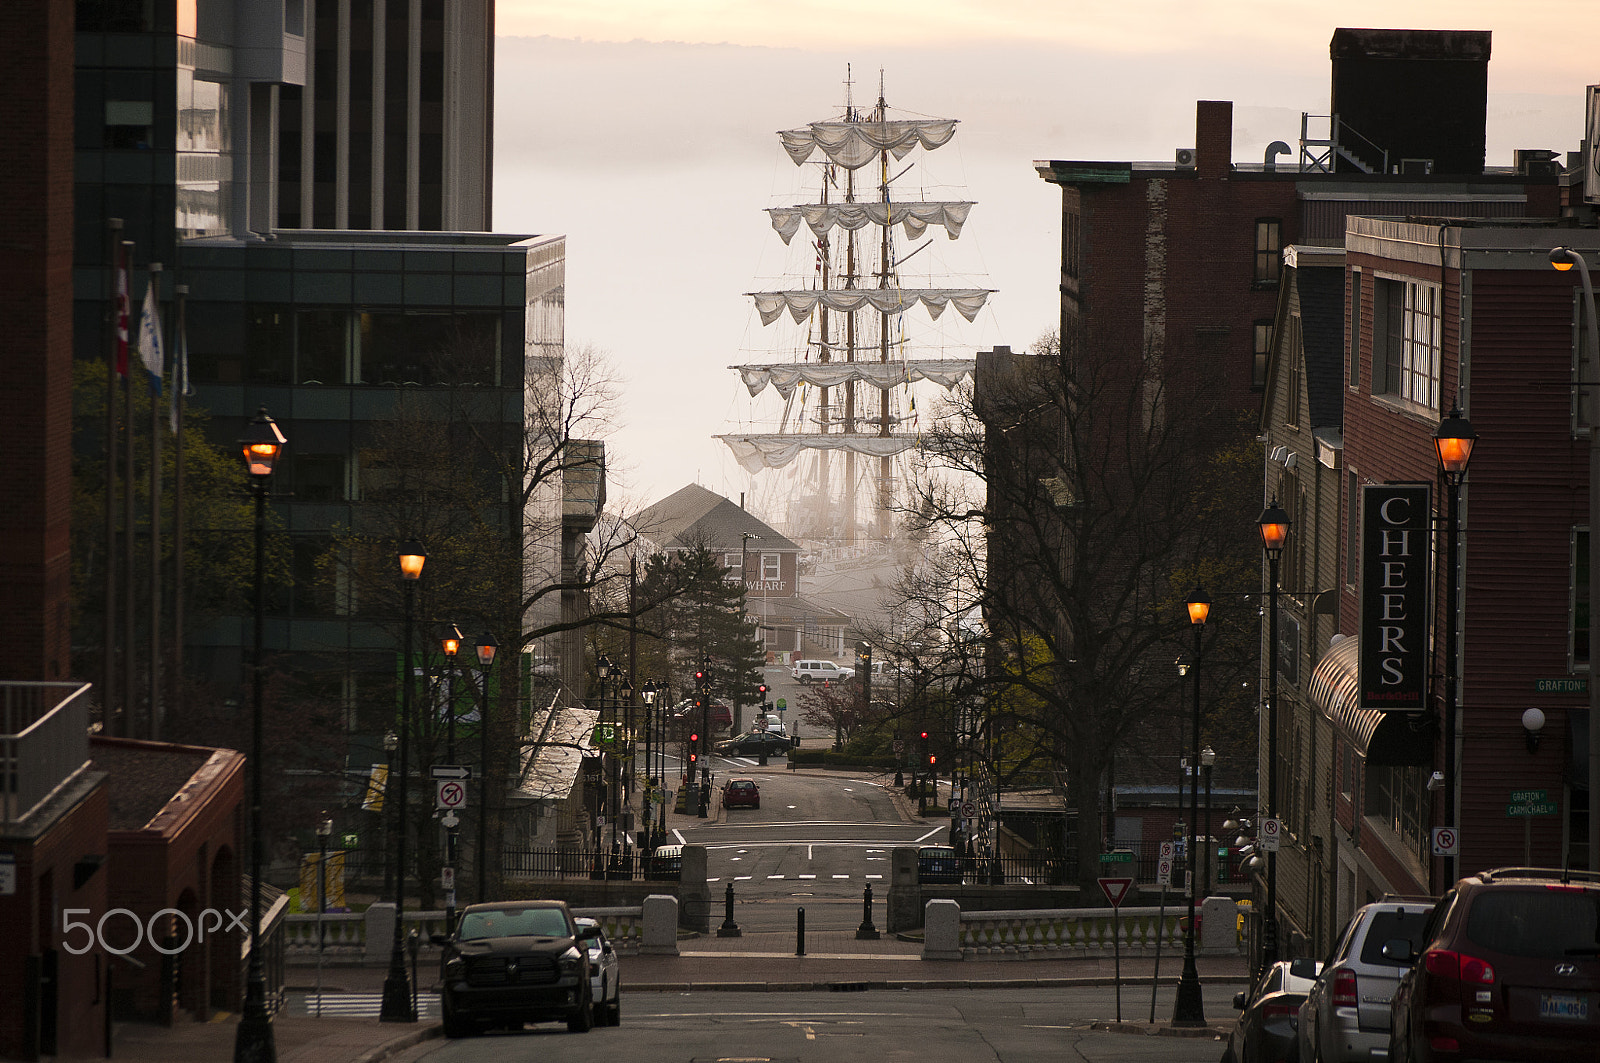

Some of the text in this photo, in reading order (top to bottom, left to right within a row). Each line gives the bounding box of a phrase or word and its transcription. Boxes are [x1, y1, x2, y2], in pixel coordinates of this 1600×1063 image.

[746, 581, 787, 591] WHARF
[1377, 497, 1413, 686] CHEERS
[1538, 680, 1581, 691] GRAFTON
[1367, 691, 1419, 701] Bar&Grill
[1512, 791, 1540, 802] GRAFTON
[1509, 804, 1548, 815] CARMICHAEL
